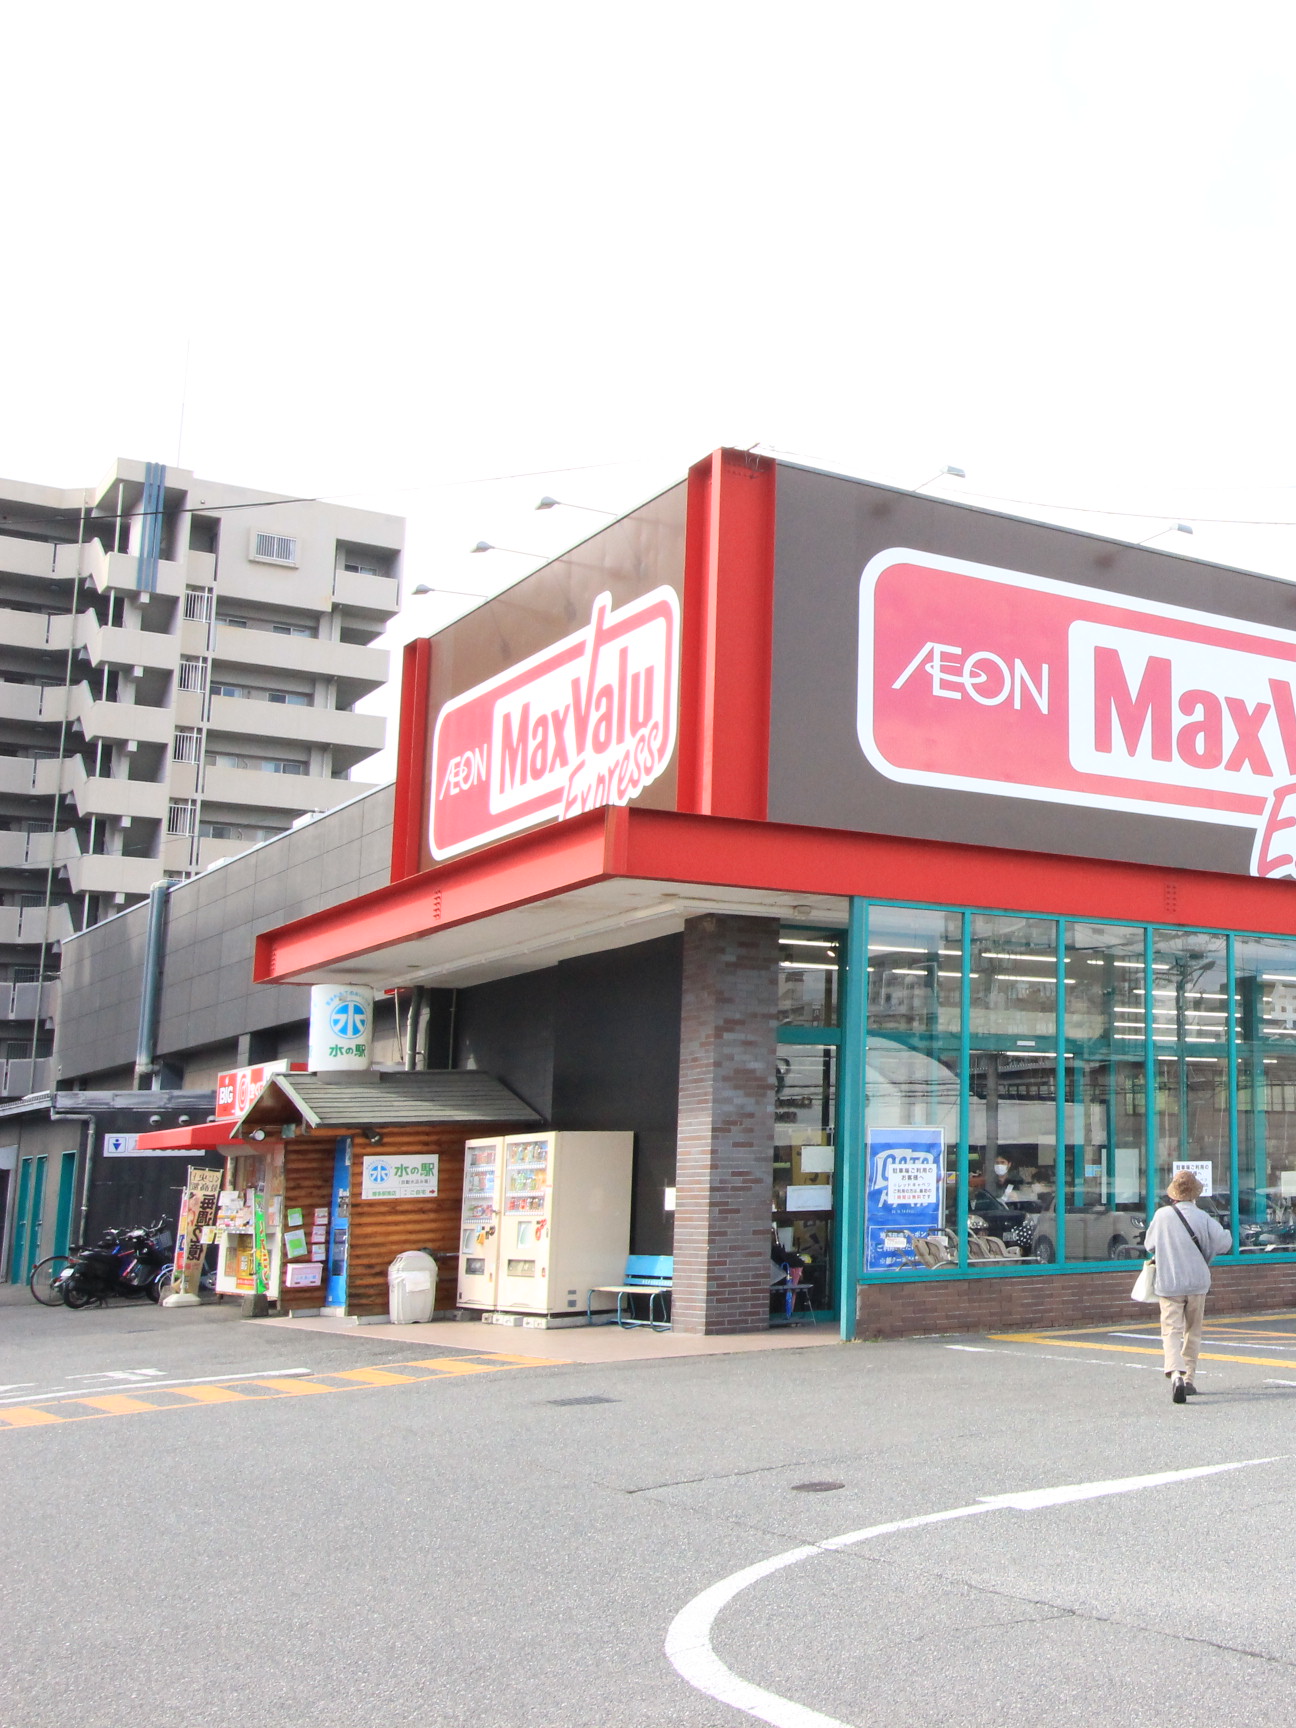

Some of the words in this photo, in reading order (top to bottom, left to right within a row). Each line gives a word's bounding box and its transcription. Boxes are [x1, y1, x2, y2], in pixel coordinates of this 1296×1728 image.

[499, 604, 655, 795] MaxValu
[329, 1044, 366, 1057] 水の駅
[218, 1085, 234, 1105] BIG
[394, 1162, 435, 1178] 水の駅
